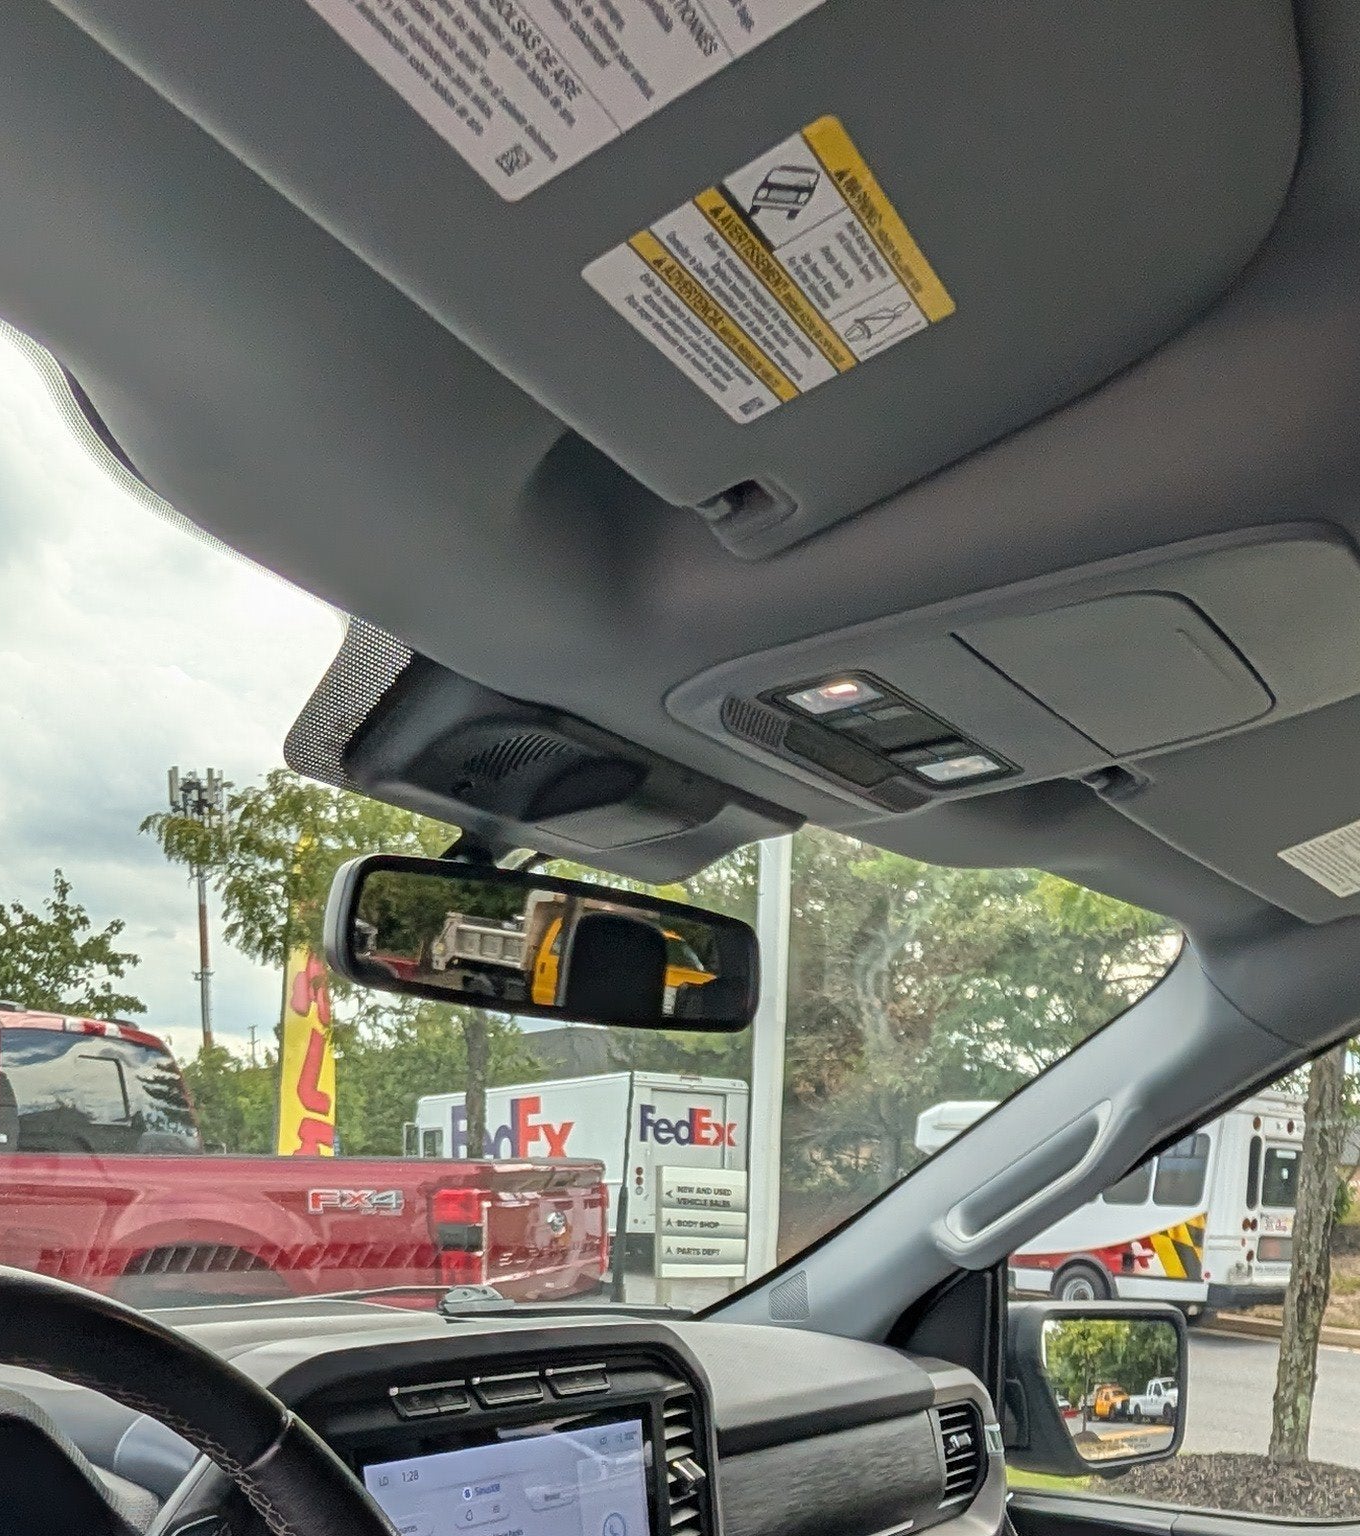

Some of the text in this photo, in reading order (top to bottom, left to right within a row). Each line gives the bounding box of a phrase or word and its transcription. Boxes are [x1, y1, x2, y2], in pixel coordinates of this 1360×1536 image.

[640, 1104, 737, 1147] FedEx
[696, 1187, 712, 1195] AND
[713, 1188, 732, 1196] USED
[307, 1188, 405, 1214] FX4
[700, 1221, 720, 1229] SHOP
[676, 1247, 721, 1256] PARTS DEPT
[402, 1470, 419, 1482] 1:28
